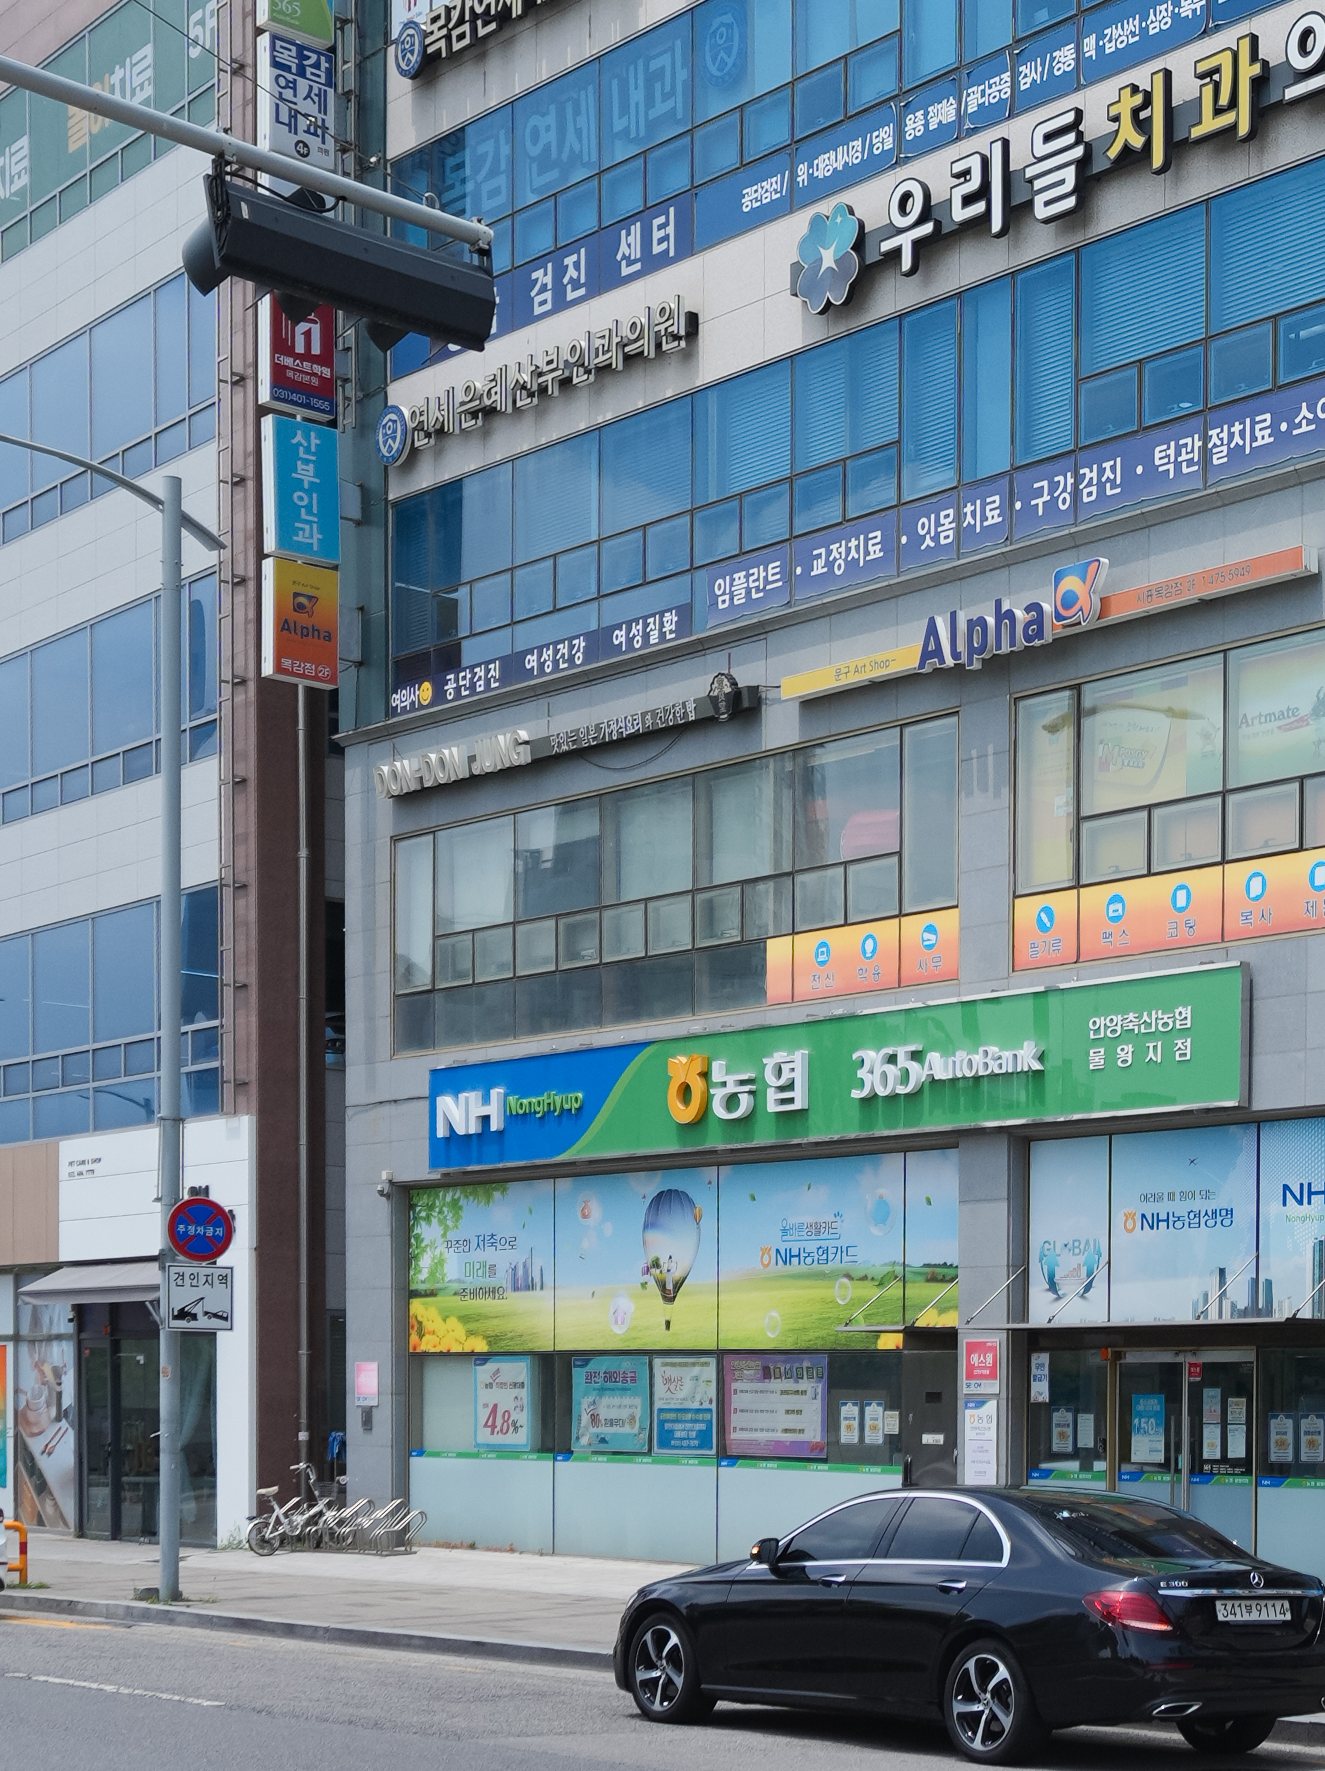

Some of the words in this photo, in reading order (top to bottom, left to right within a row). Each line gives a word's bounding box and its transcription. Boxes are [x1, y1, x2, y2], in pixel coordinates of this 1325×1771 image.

[274, 40, 330, 82] 목감
[275, 73, 329, 116] 연세
[530, 247, 586, 316] 검진
[616, 206, 675, 277] 센터
[291, 429, 323, 552] 산부인과
[714, 560, 783, 609] 임플란트
[810, 531, 884, 576] 교정치료
[917, 495, 1003, 550] 잇몸치료
[1030, 455, 1123, 517] 구강검진
[1154, 411, 1275, 479] 턱관절치료
[279, 617, 333, 644] Alpha
[917, 597, 1054, 671] Alpha
[280, 656, 316, 678] 목감점
[391, 685, 419, 713] 여의사
[444, 660, 500, 700] 공단검진
[525, 636, 586, 676] 여성건강
[612, 609, 678, 651] 여성질환
[853, 661, 867, 677] Art
[1238, 704, 1301, 730] Artmate
[471, 729, 531, 776] JUNG
[1166, 917, 1198, 941] 코팅
[1239, 907, 1273, 928] 복사
[1101, 928, 1130, 949] 팩스
[1089, 1005, 1193, 1040] 안양축산농협
[1089, 1038, 1193, 1071] 물왕지점
[709, 1049, 810, 1120] 농협
[436, 1086, 505, 1138] NH
[507, 1091, 583, 1118] NongHyup
[177, 1224, 224, 1237] 주정차금지
[1284, 1211, 1325, 1225] NongHyup
[473, 1232, 517, 1253] 저축으로
[173, 1270, 229, 1290] 견인지역
[970, 1351, 993, 1368] 에스원
